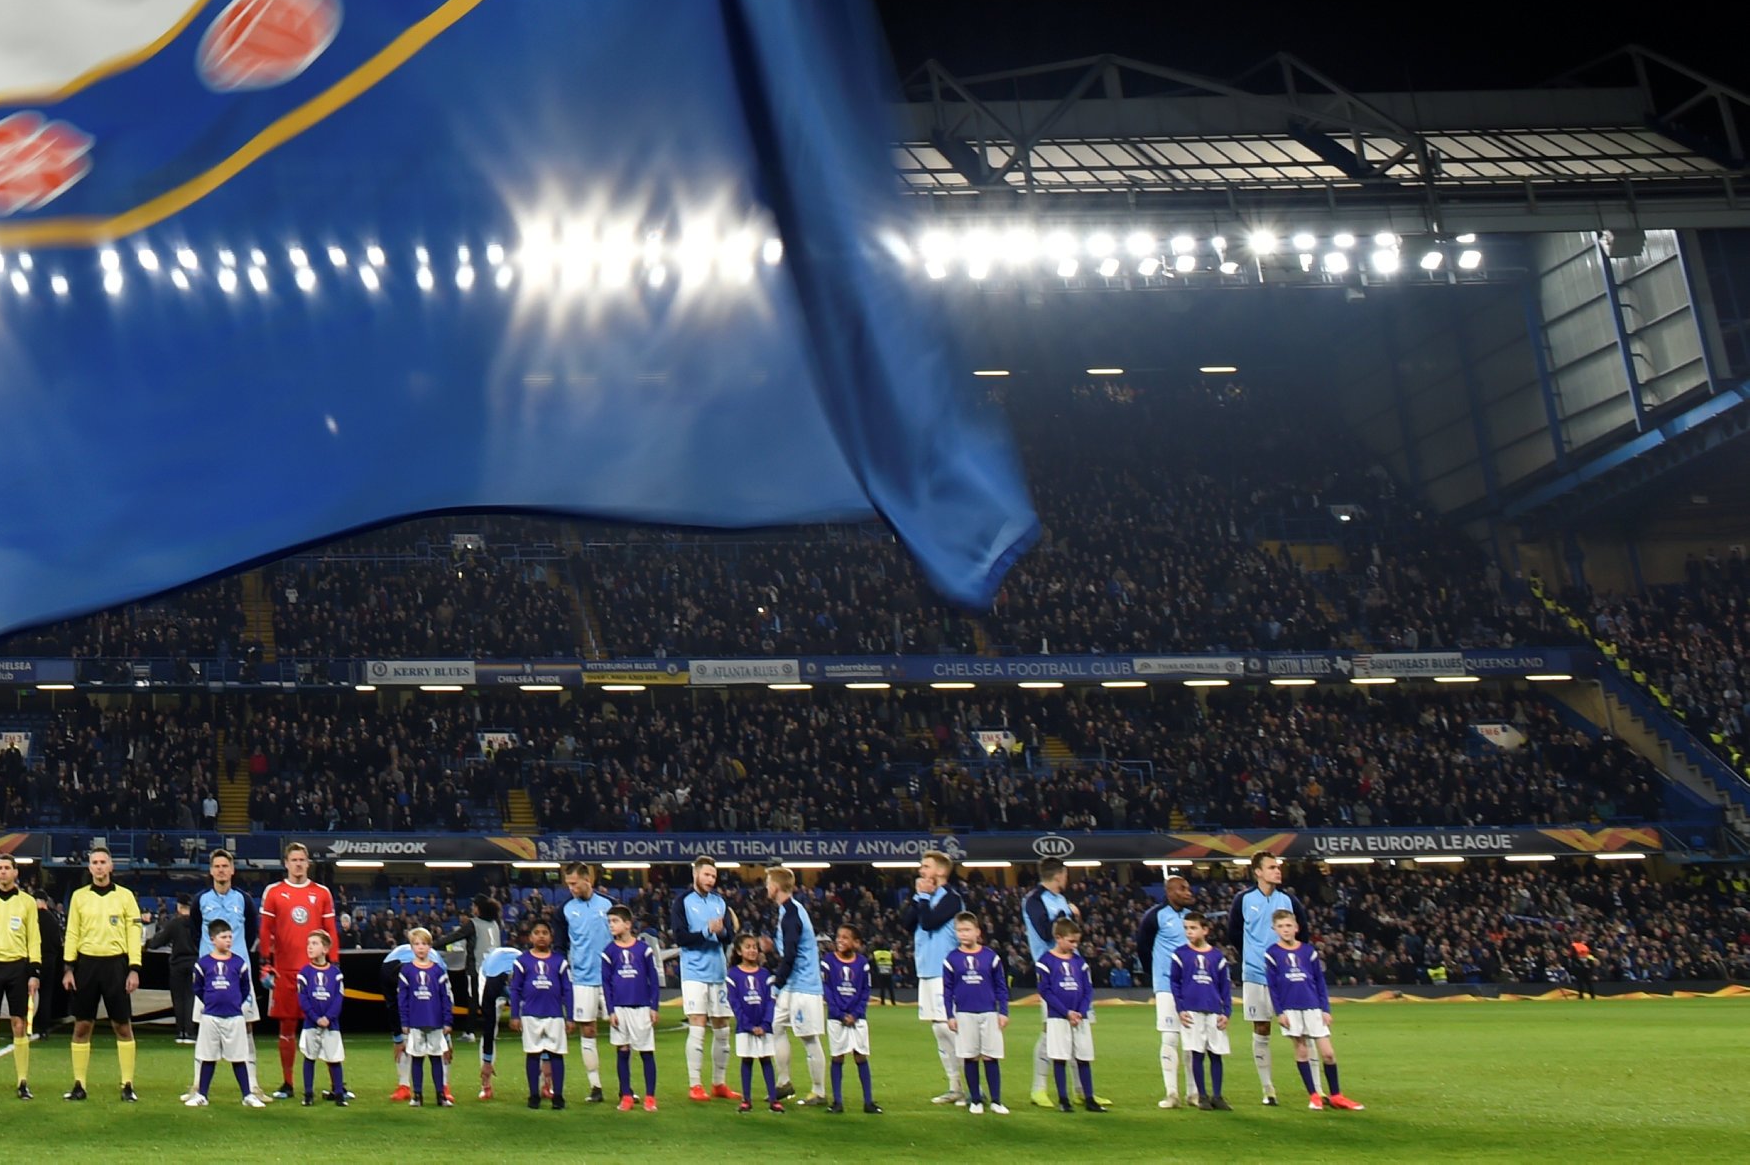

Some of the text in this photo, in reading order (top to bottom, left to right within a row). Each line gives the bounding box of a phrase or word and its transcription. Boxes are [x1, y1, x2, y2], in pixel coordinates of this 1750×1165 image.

[933, 662, 1131, 676] CHELSEA FOOTBALL CLUB
[1268, 658, 1331, 674] AUSTIN BLUES
[1432, 657, 1463, 669] BLUES
[1464, 657, 1543, 671] QUEENSLAND
[393, 667, 470, 677] KERRY BLUES
[713, 665, 779, 677] ATLANTA BLUES
[497, 675, 535, 683] CHELSEA
[577, 840, 939, 855] THEY DON'T MAKE THEM LIKE RAY ANYMORE
[1039, 841, 1068, 853] KIA
[1314, 834, 1513, 851] UEFA EUROPA LEAGUE
